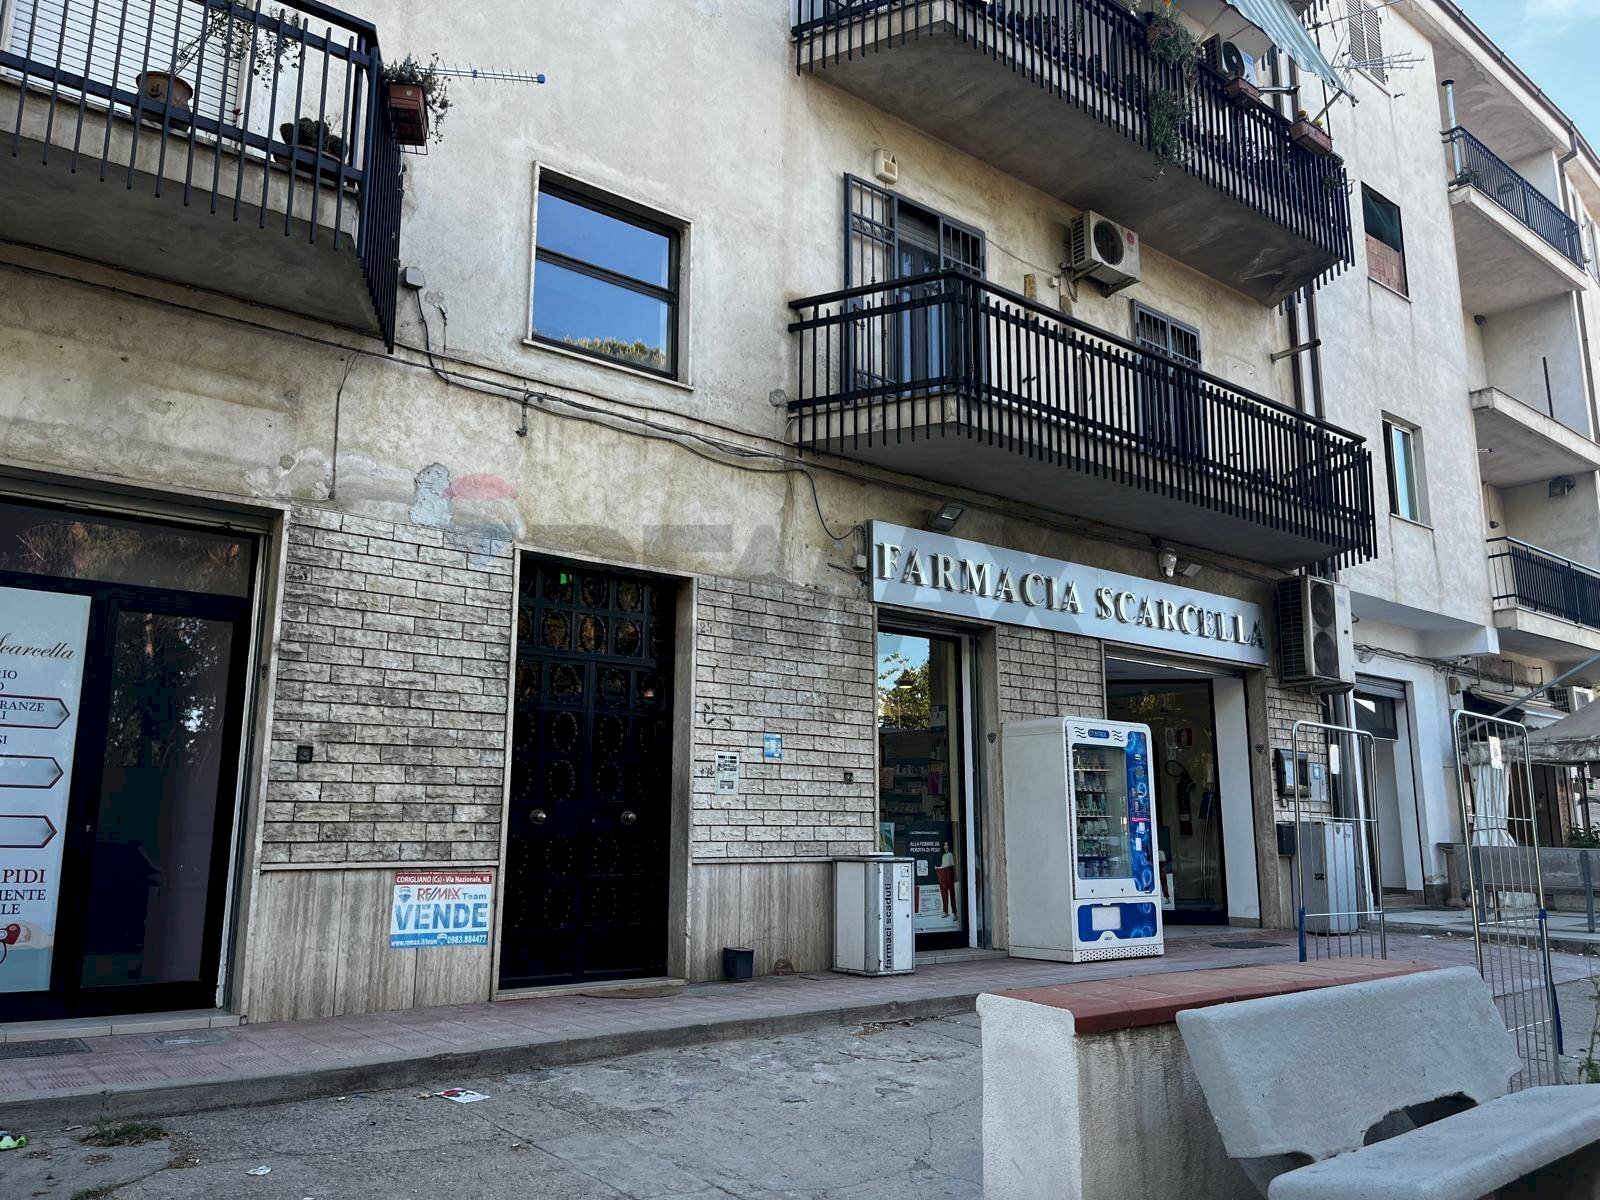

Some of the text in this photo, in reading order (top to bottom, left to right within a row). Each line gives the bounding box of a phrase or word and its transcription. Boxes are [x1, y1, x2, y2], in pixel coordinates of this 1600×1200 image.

[876, 541, 1266, 649] FARMACIA SCARCELLA
[0, 669, 17, 680] IO
[2, 868, 47, 884] PIDI
[396, 876, 432, 884] CORIGLIANO
[462, 892, 487, 900] Team
[395, 902, 488, 931] VENDE
